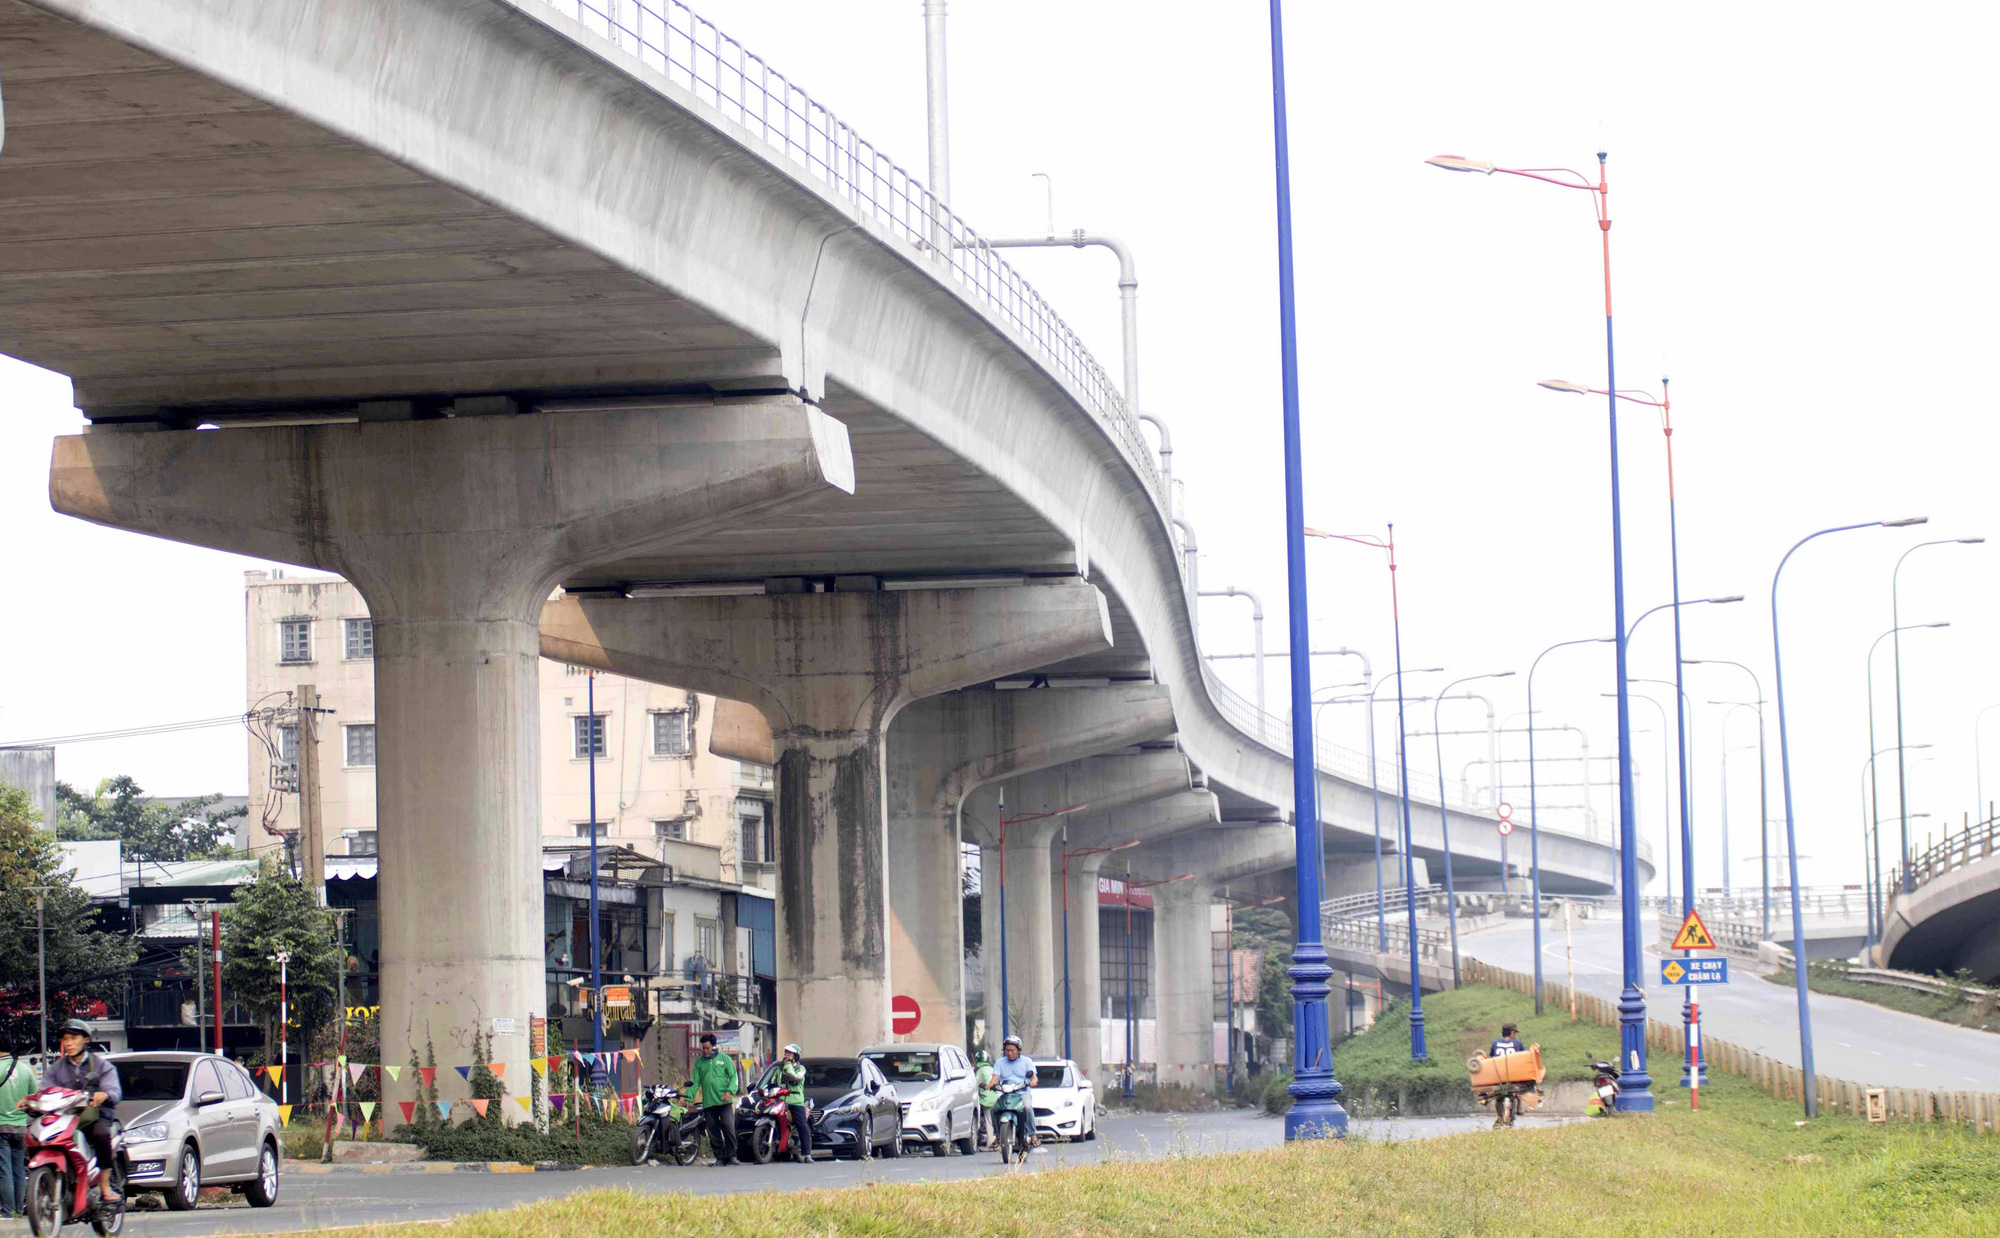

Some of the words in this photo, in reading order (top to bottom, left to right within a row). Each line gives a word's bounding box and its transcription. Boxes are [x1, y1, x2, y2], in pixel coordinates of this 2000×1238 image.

[1098, 877, 1110, 894] GIA
[1690, 962, 1701, 970] XE
[1702, 961, 1723, 971] CHẠY
[1688, 971, 1710, 982] CHẬM
